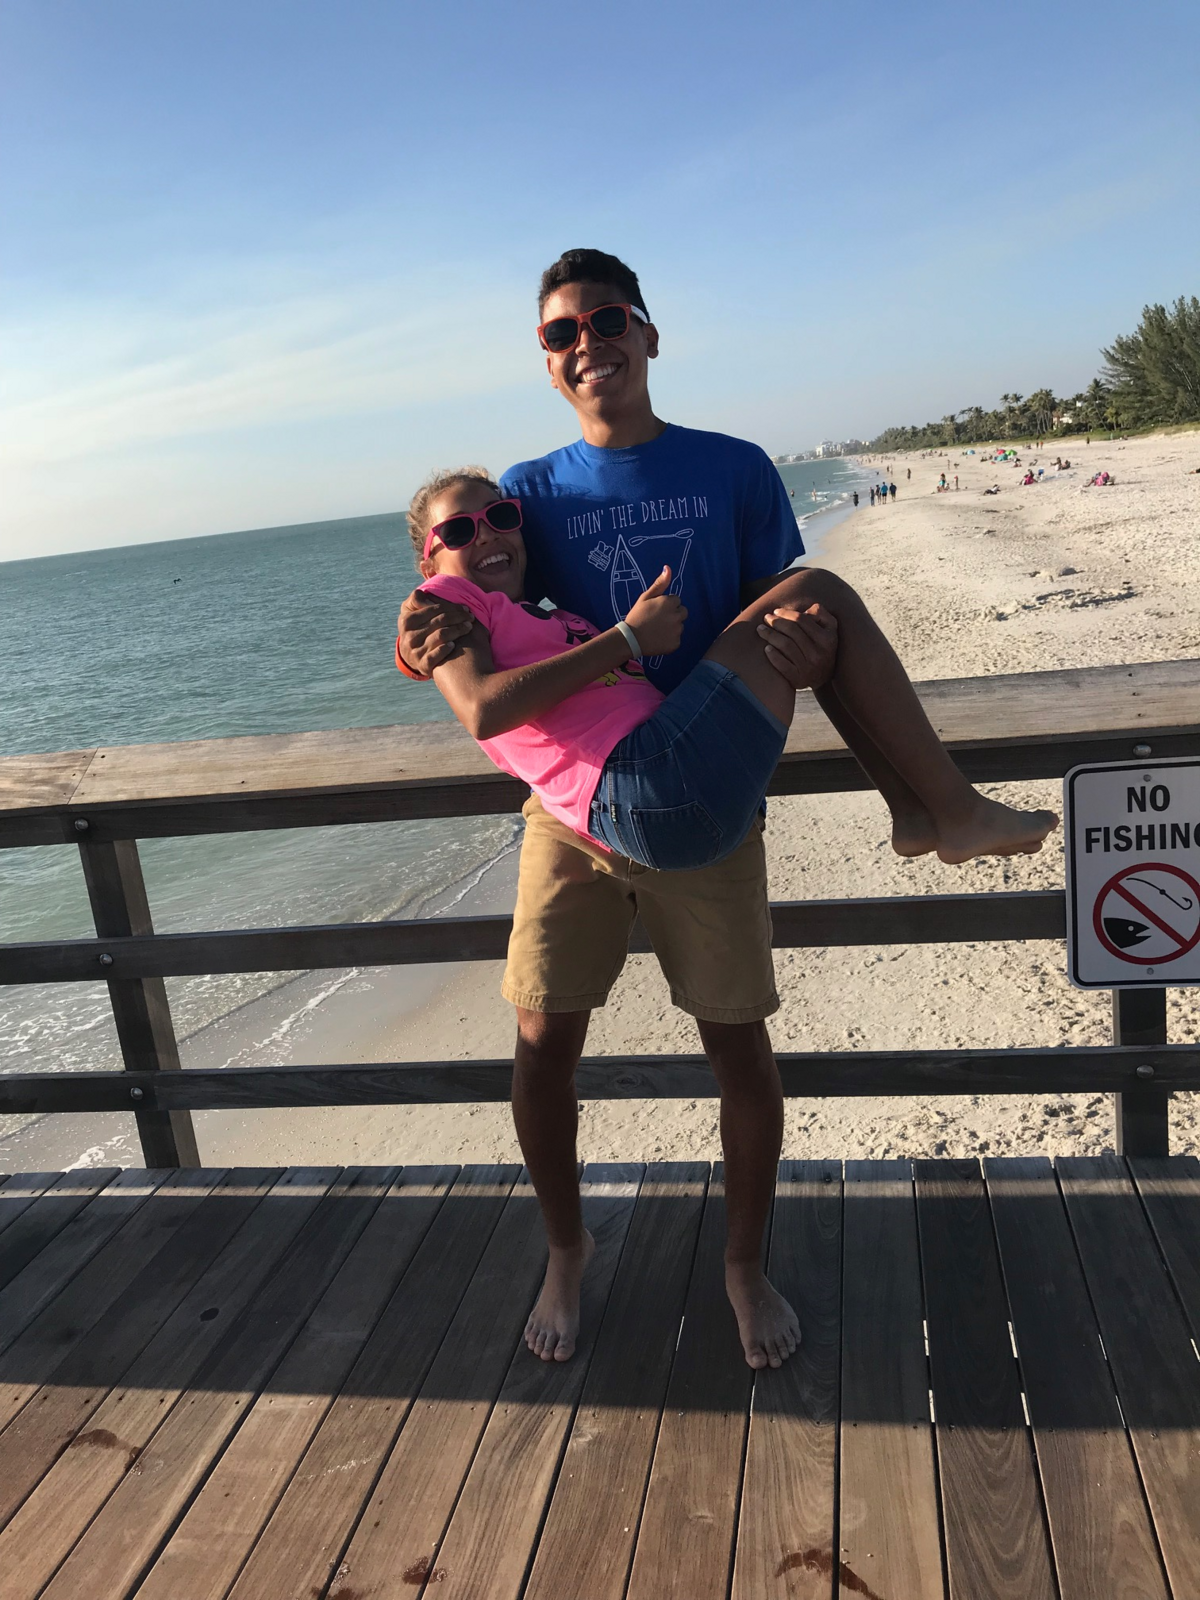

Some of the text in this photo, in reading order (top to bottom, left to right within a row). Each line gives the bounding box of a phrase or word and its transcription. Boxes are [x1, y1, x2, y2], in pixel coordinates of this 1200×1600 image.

[567, 496, 709, 540] LIVIN' THE DREAM IN
[1127, 784, 1171, 813] NO
